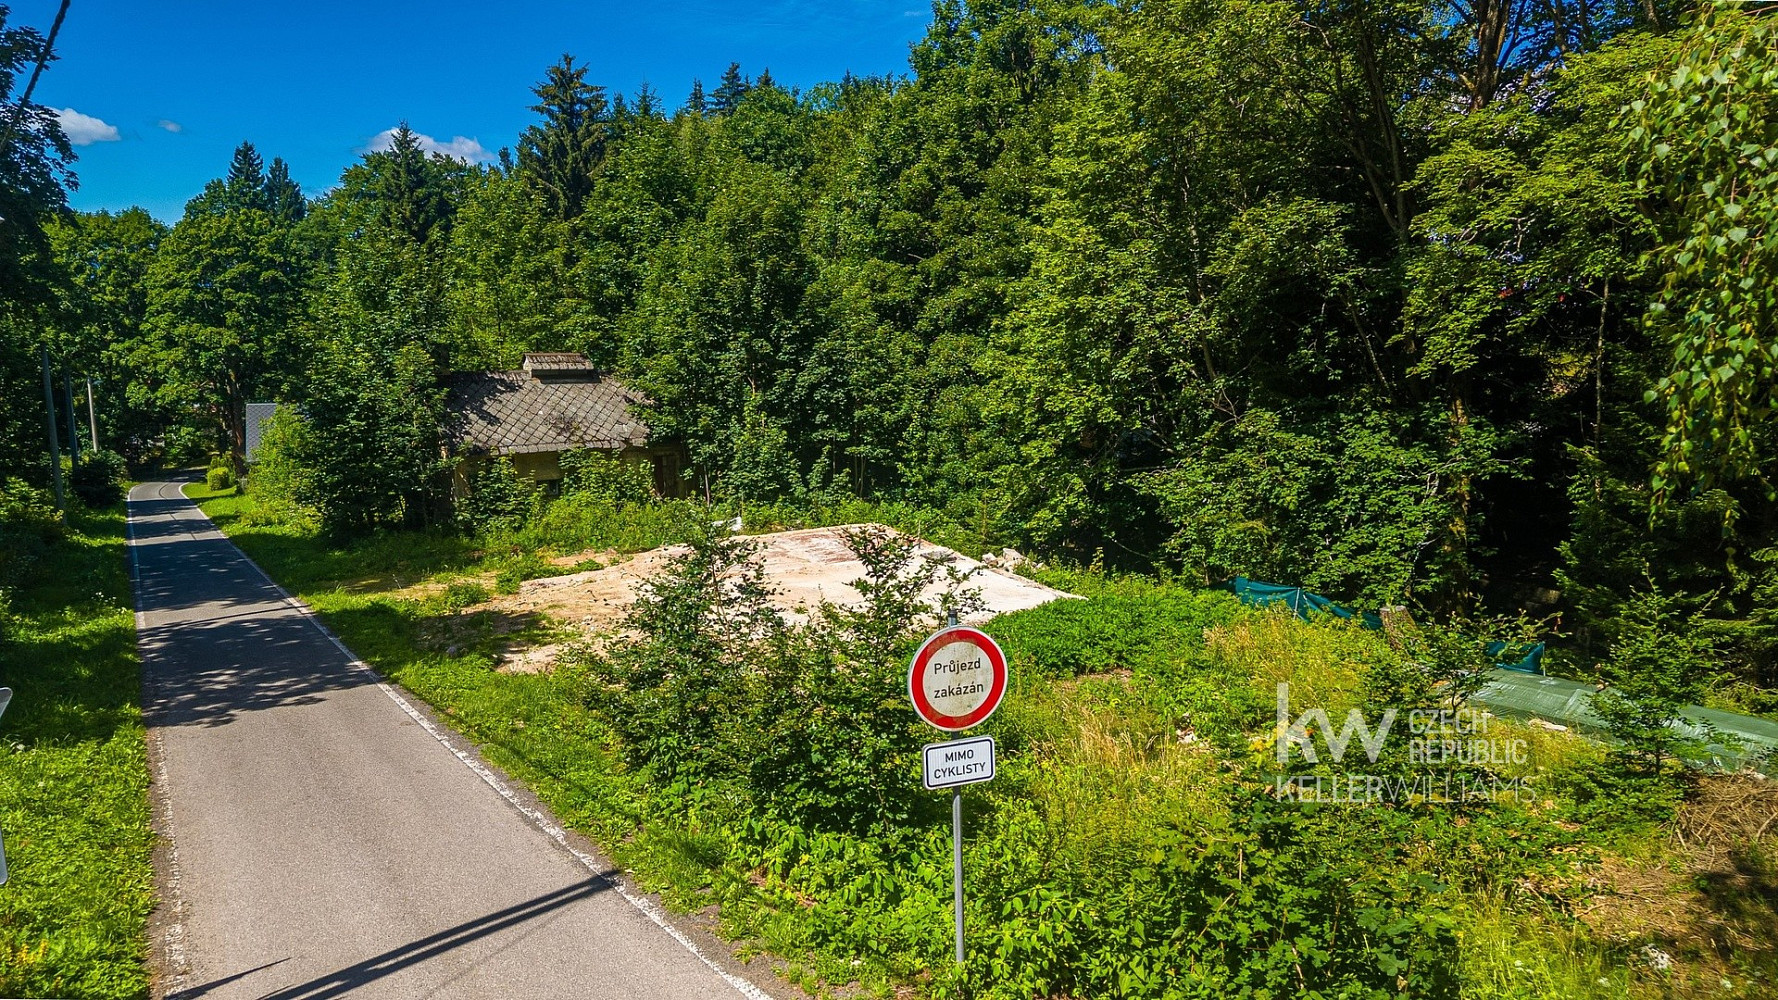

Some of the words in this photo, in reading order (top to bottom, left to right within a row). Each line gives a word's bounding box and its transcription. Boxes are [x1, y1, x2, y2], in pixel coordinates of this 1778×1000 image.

[934, 658, 981, 674] Průjezd
[934, 681, 984, 698] zakázán
[945, 749, 974, 763] MIMO
[934, 762, 986, 779] CYKLISTY
